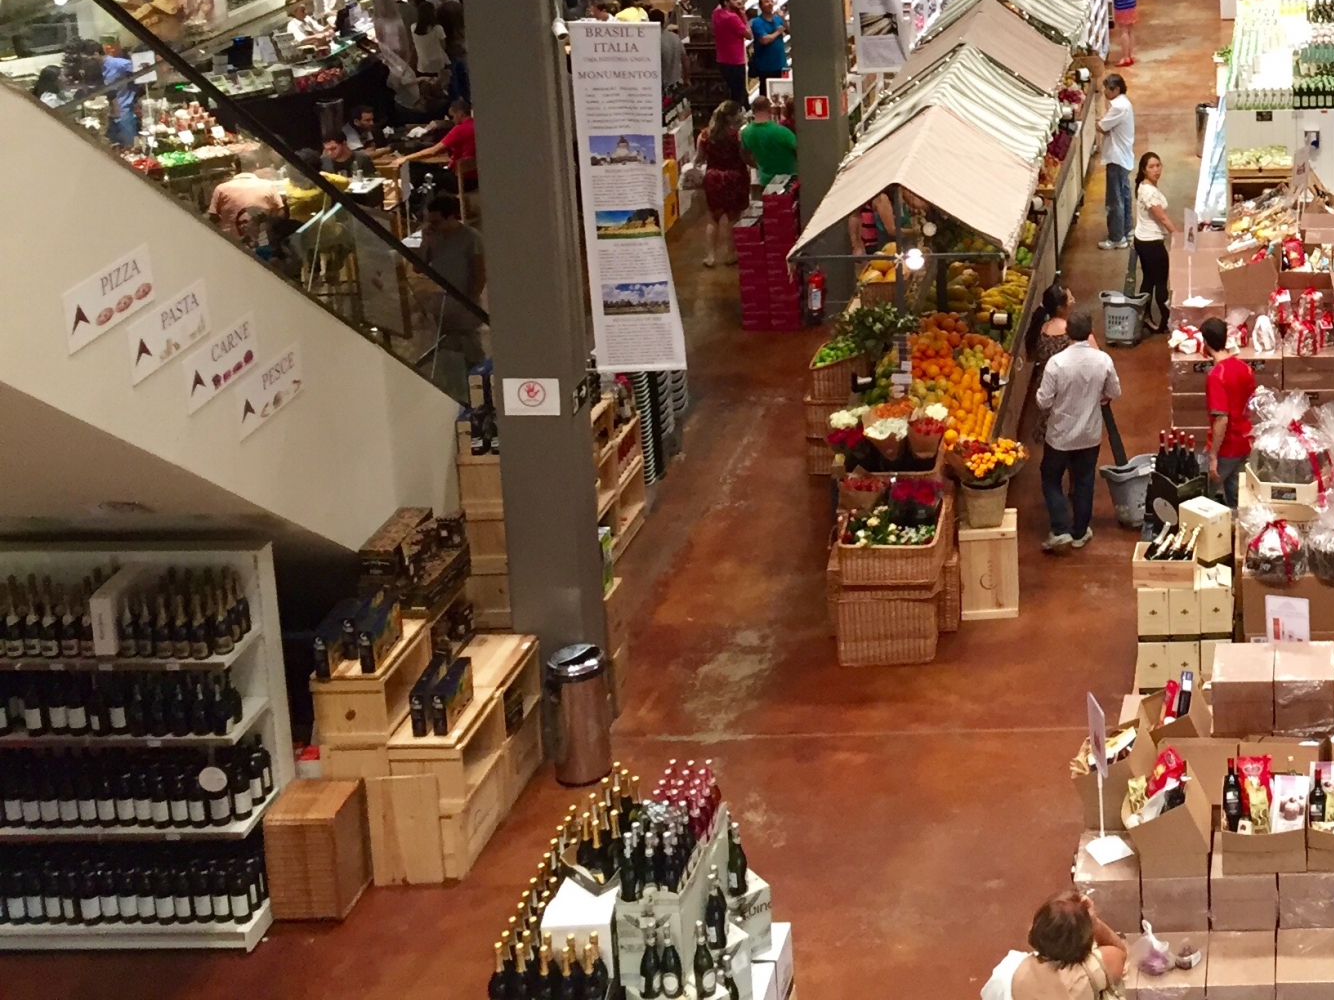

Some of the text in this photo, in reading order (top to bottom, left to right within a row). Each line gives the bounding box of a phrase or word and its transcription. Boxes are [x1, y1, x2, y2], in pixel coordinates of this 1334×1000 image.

[585, 27, 645, 38] BRASIL E
[578, 71, 659, 80] MONUMENTOS
[100, 259, 141, 296] PIZZA
[160, 292, 200, 330] PASTA
[211, 321, 251, 362] CARNE
[261, 351, 295, 390] PESCE
